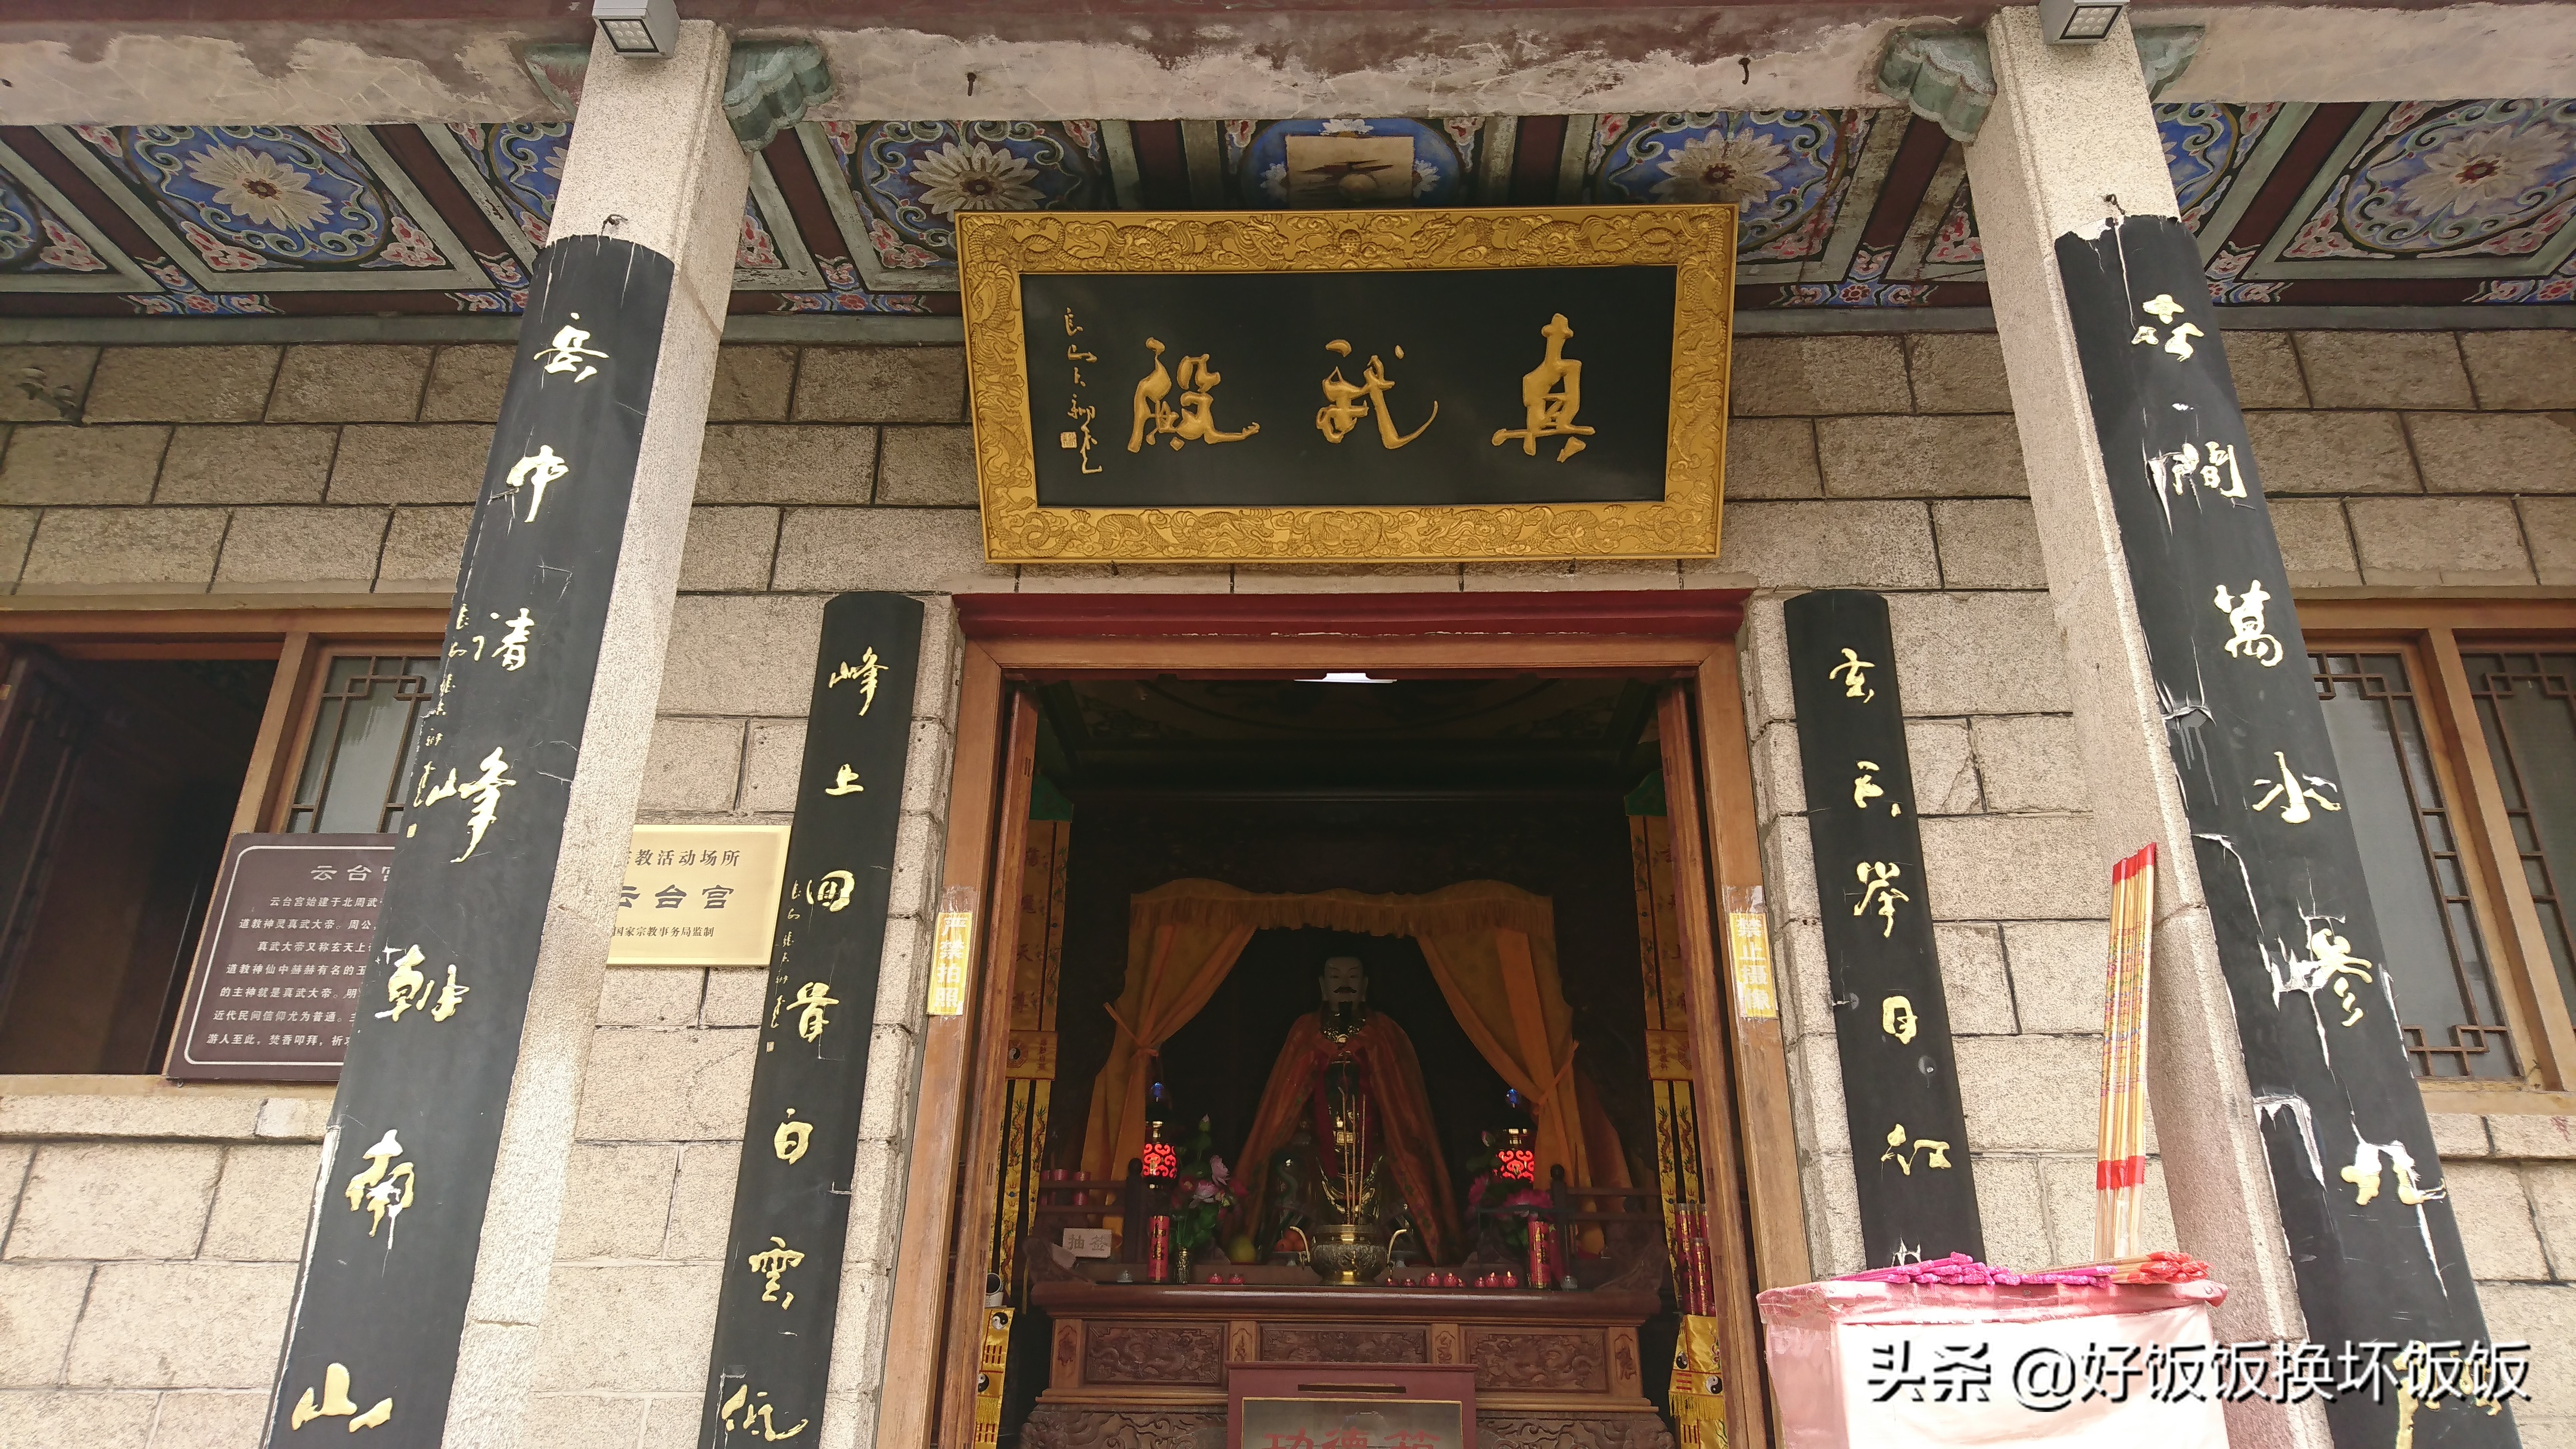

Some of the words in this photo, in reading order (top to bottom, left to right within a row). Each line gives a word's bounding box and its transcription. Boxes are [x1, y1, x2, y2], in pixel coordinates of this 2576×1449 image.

[1127, 313, 1595, 462] 真武殿
[626, 849, 740, 867] 教活动场所
[269, 896, 384, 907] 云台宫始建于北周武
[619, 885, 734, 909] 云台宫
[613, 926, 715, 938] 国家宗教事务局监制
[934, 917, 968, 1008] 严禁拍照
[1736, 918, 1771, 1010] 禁止摄像
